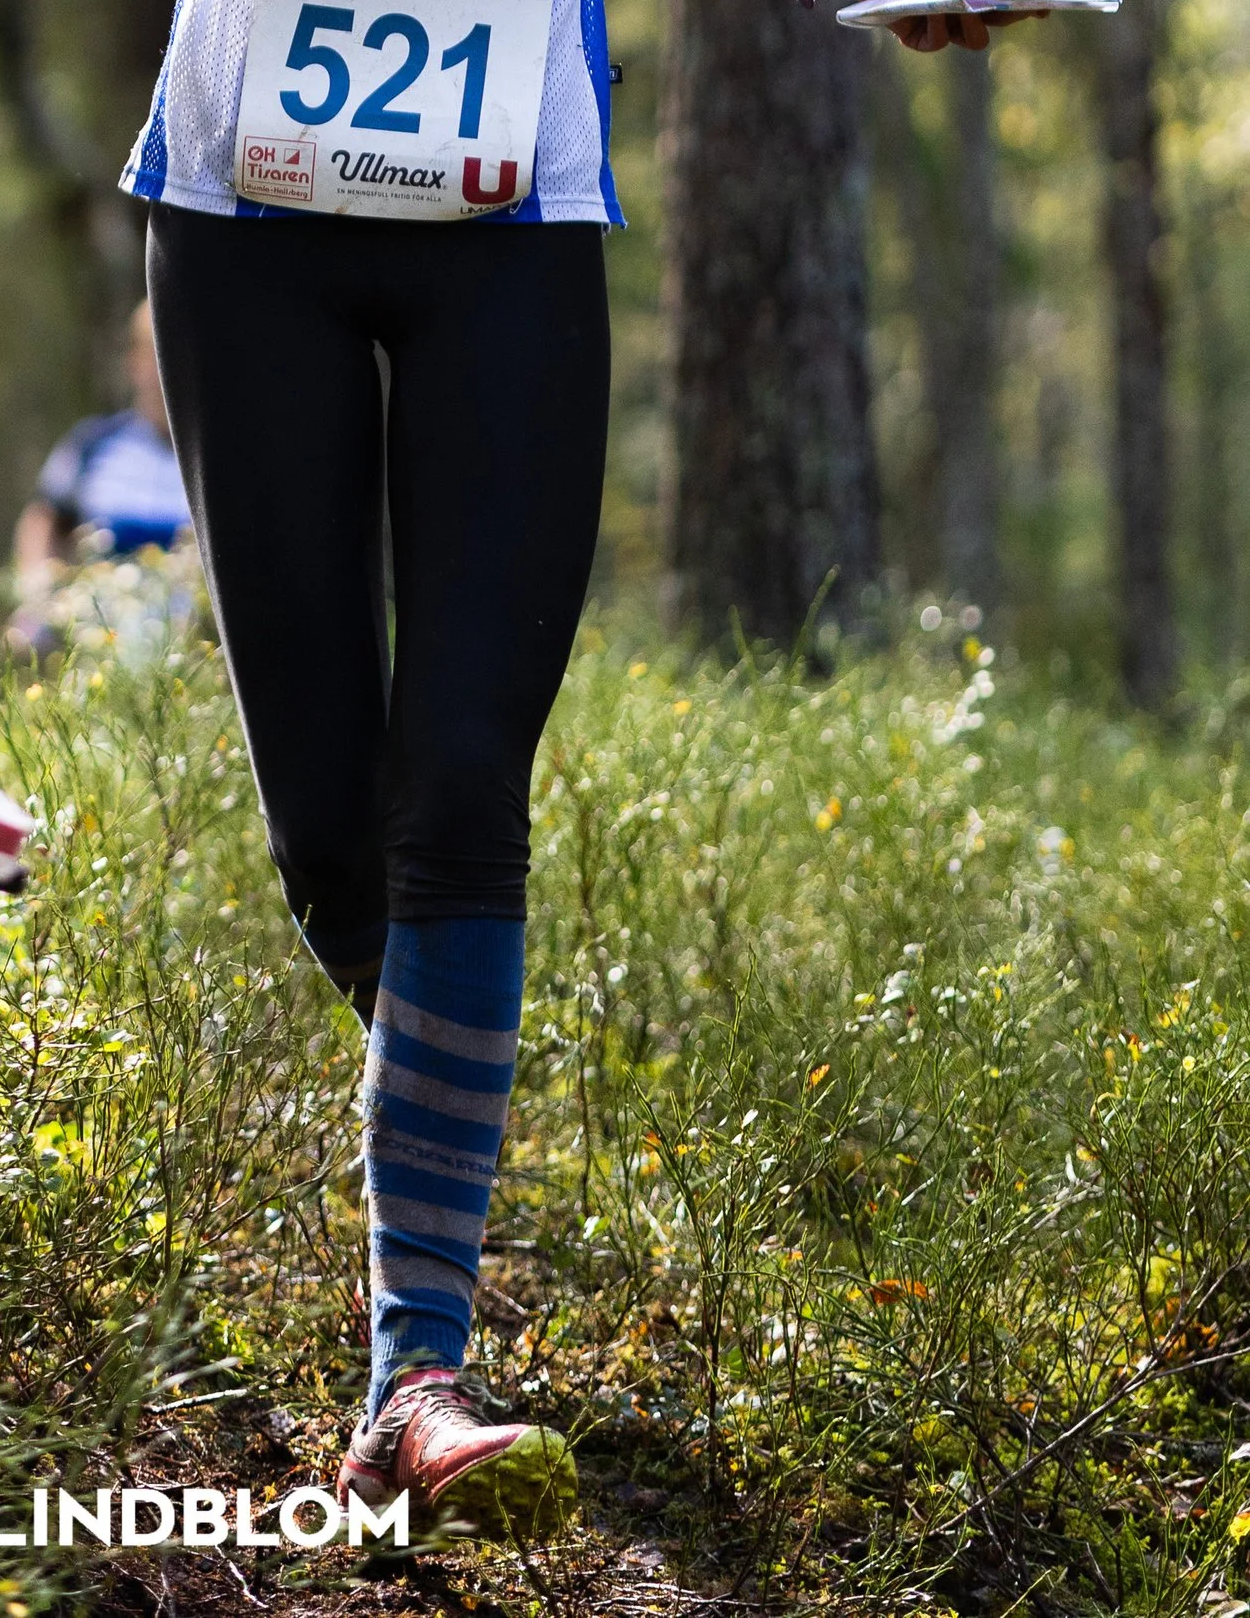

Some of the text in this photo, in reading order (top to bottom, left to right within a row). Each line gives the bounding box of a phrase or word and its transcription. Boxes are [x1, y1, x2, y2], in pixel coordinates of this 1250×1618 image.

[279, 3, 492, 140] 521
[247, 162, 310, 184] Tisaren
[331, 149, 446, 190] Ullmax
